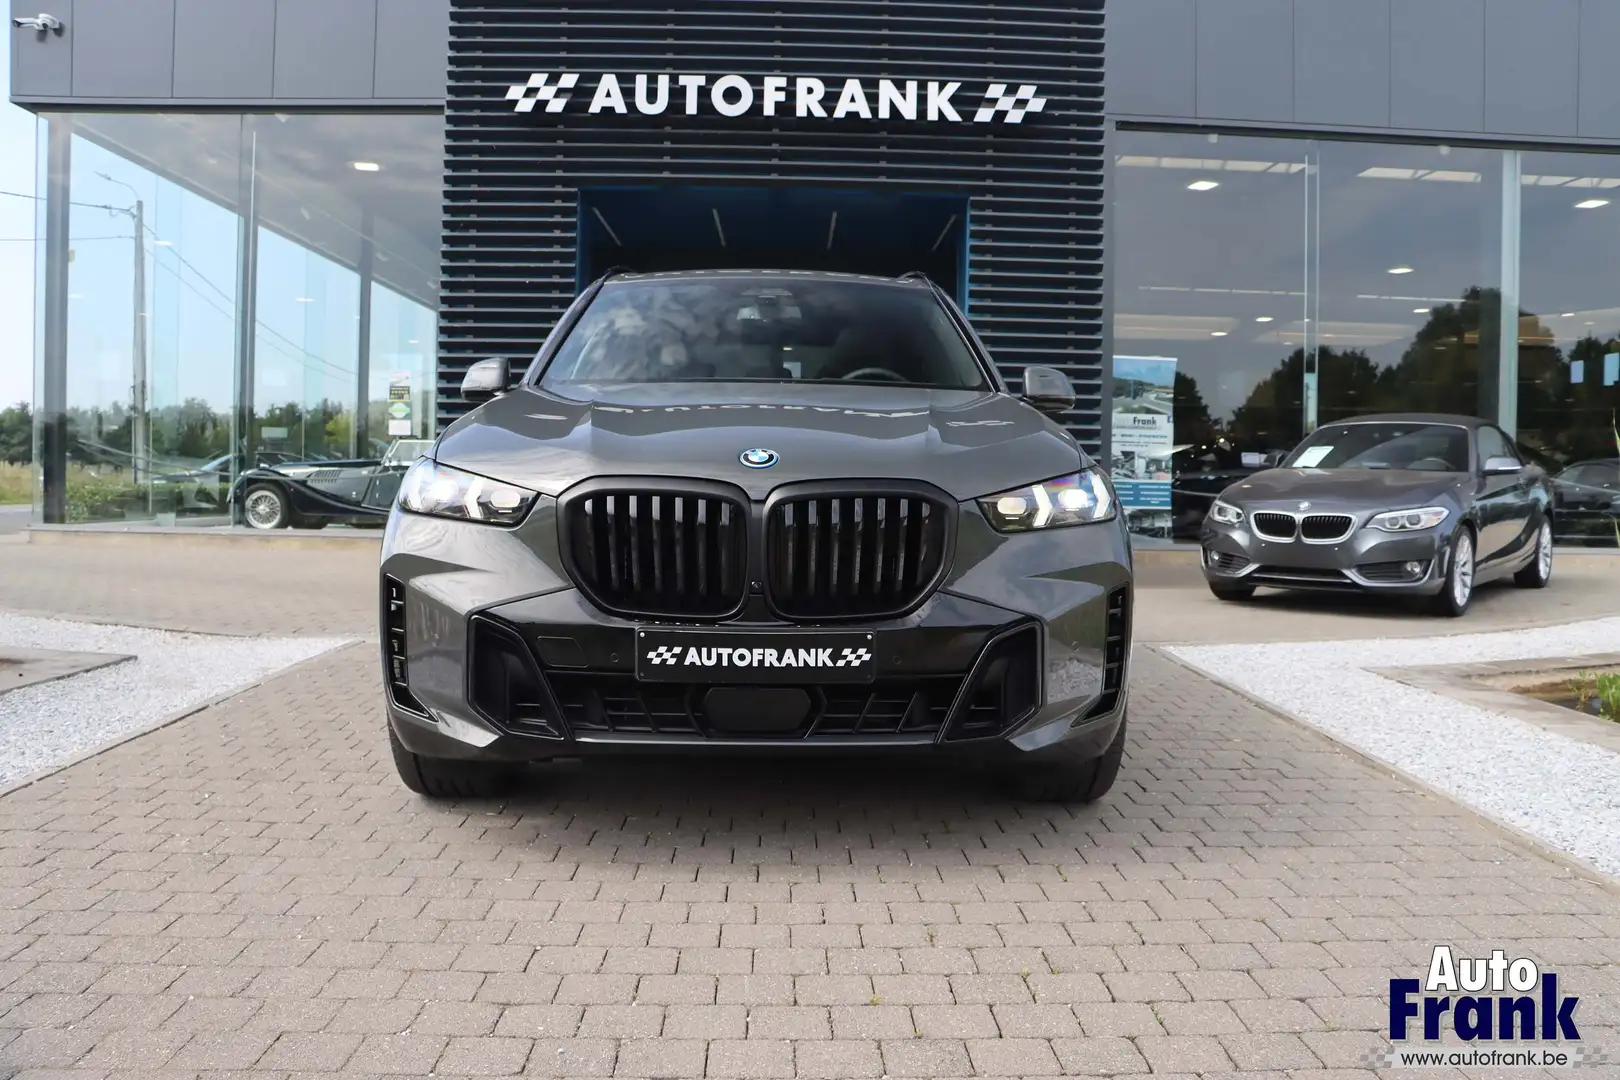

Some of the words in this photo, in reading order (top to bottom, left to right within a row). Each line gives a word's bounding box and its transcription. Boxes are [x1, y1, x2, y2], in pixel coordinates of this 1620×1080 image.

[587, 73, 963, 122] AUTOFRANK
[1133, 416, 1156, 425] Frank
[684, 647, 834, 667] AUTOFRANK
